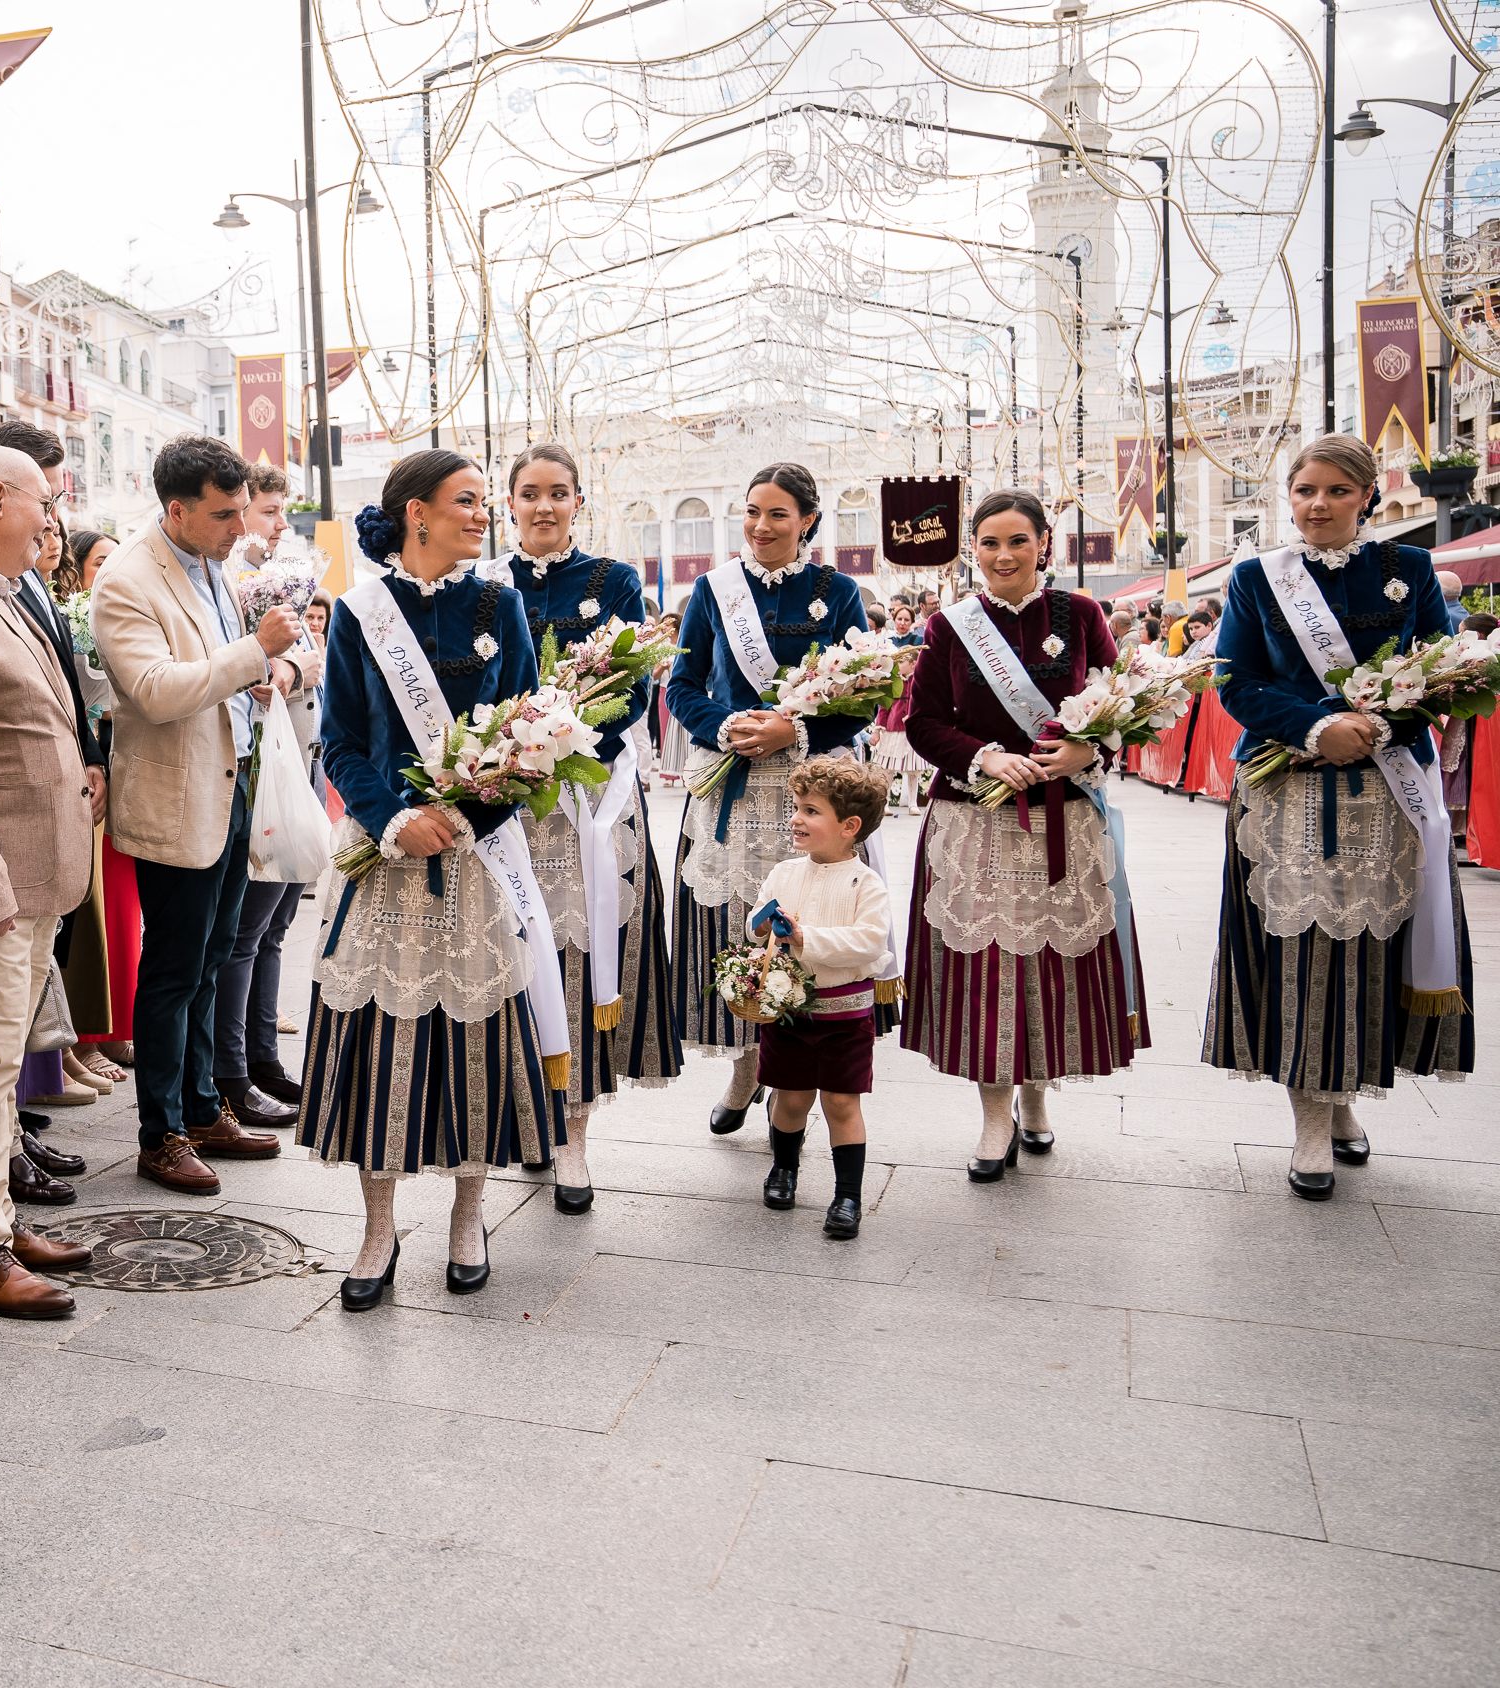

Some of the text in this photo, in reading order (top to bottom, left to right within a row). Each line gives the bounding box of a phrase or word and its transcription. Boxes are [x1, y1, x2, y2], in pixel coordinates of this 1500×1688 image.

[1376, 318, 1404, 328] HONOR
[241, 371, 282, 385] ARACELI
[913, 528, 947, 545] LUCENTINA
[918, 515, 943, 531] CORAL
[733, 616, 761, 665] DAMA
[1294, 600, 1334, 652] DAMA
[386, 645, 429, 711] DAMA
[1382, 747, 1427, 814] R 2026
[482, 833, 532, 911] R 2026
